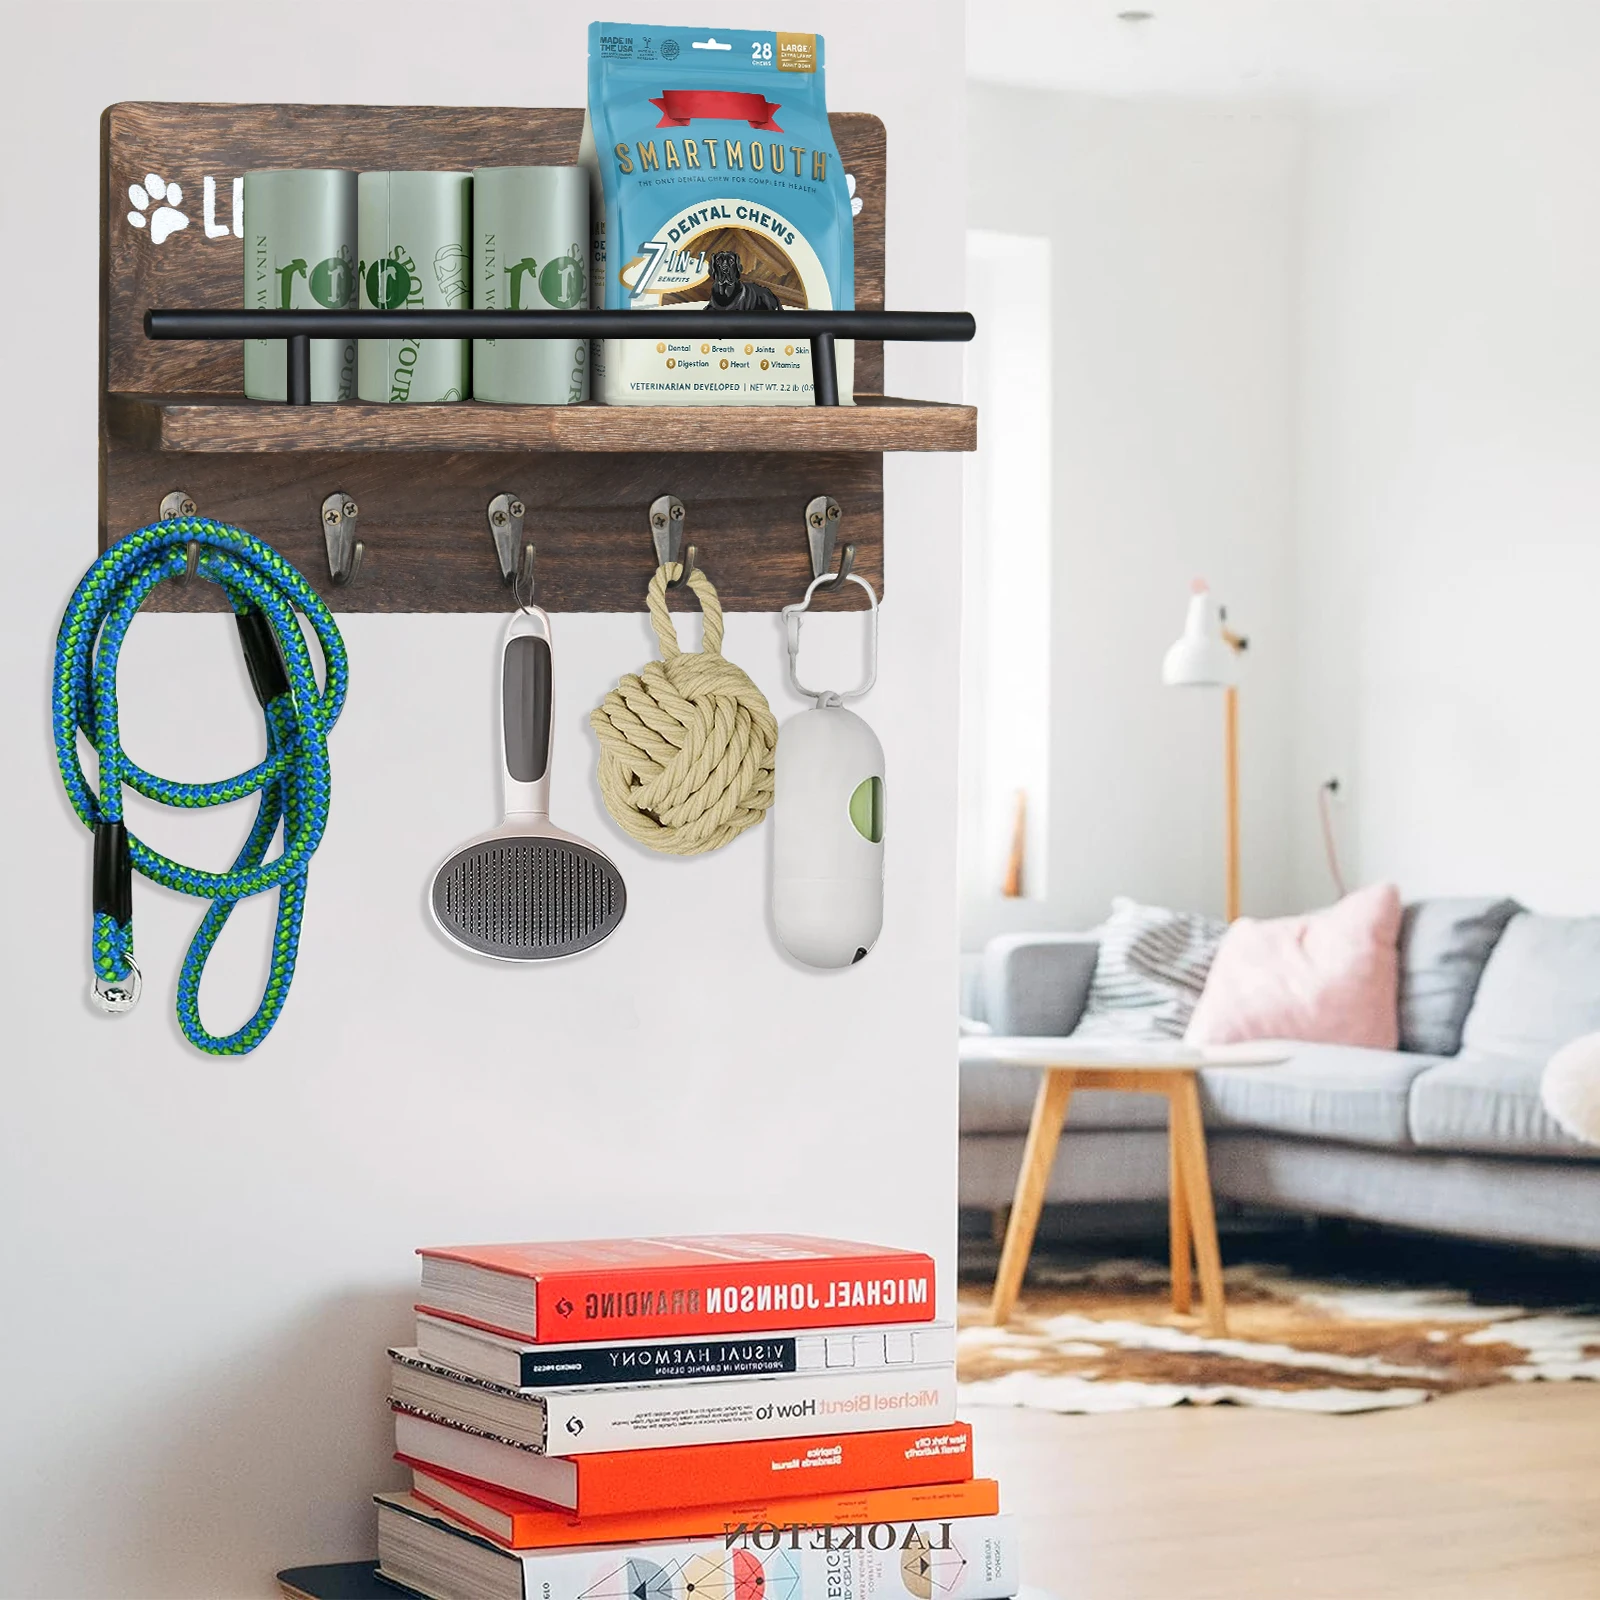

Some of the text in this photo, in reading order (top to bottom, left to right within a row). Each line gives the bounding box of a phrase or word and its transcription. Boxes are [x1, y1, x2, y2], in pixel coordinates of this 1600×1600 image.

[752, 42, 772, 60] 28
[655, 177, 675, 185] ONLY
[749, 177, 785, 188] COMPLETE
[788, 182, 817, 194] HEALTH
[666, 205, 795, 246] DENTAL CHEWS
[257, 236, 267, 282] NINA
[485, 233, 496, 281] NINA
[388, 245, 424, 309] SPOI
[668, 344, 691, 352] Dental
[711, 345, 734, 353] Breath
[678, 360, 709, 369] Digestion
[771, 361, 800, 369] Vitamins
[630, 382, 691, 391] VETERINARIAN
[694, 383, 740, 391] DEVELOPED
